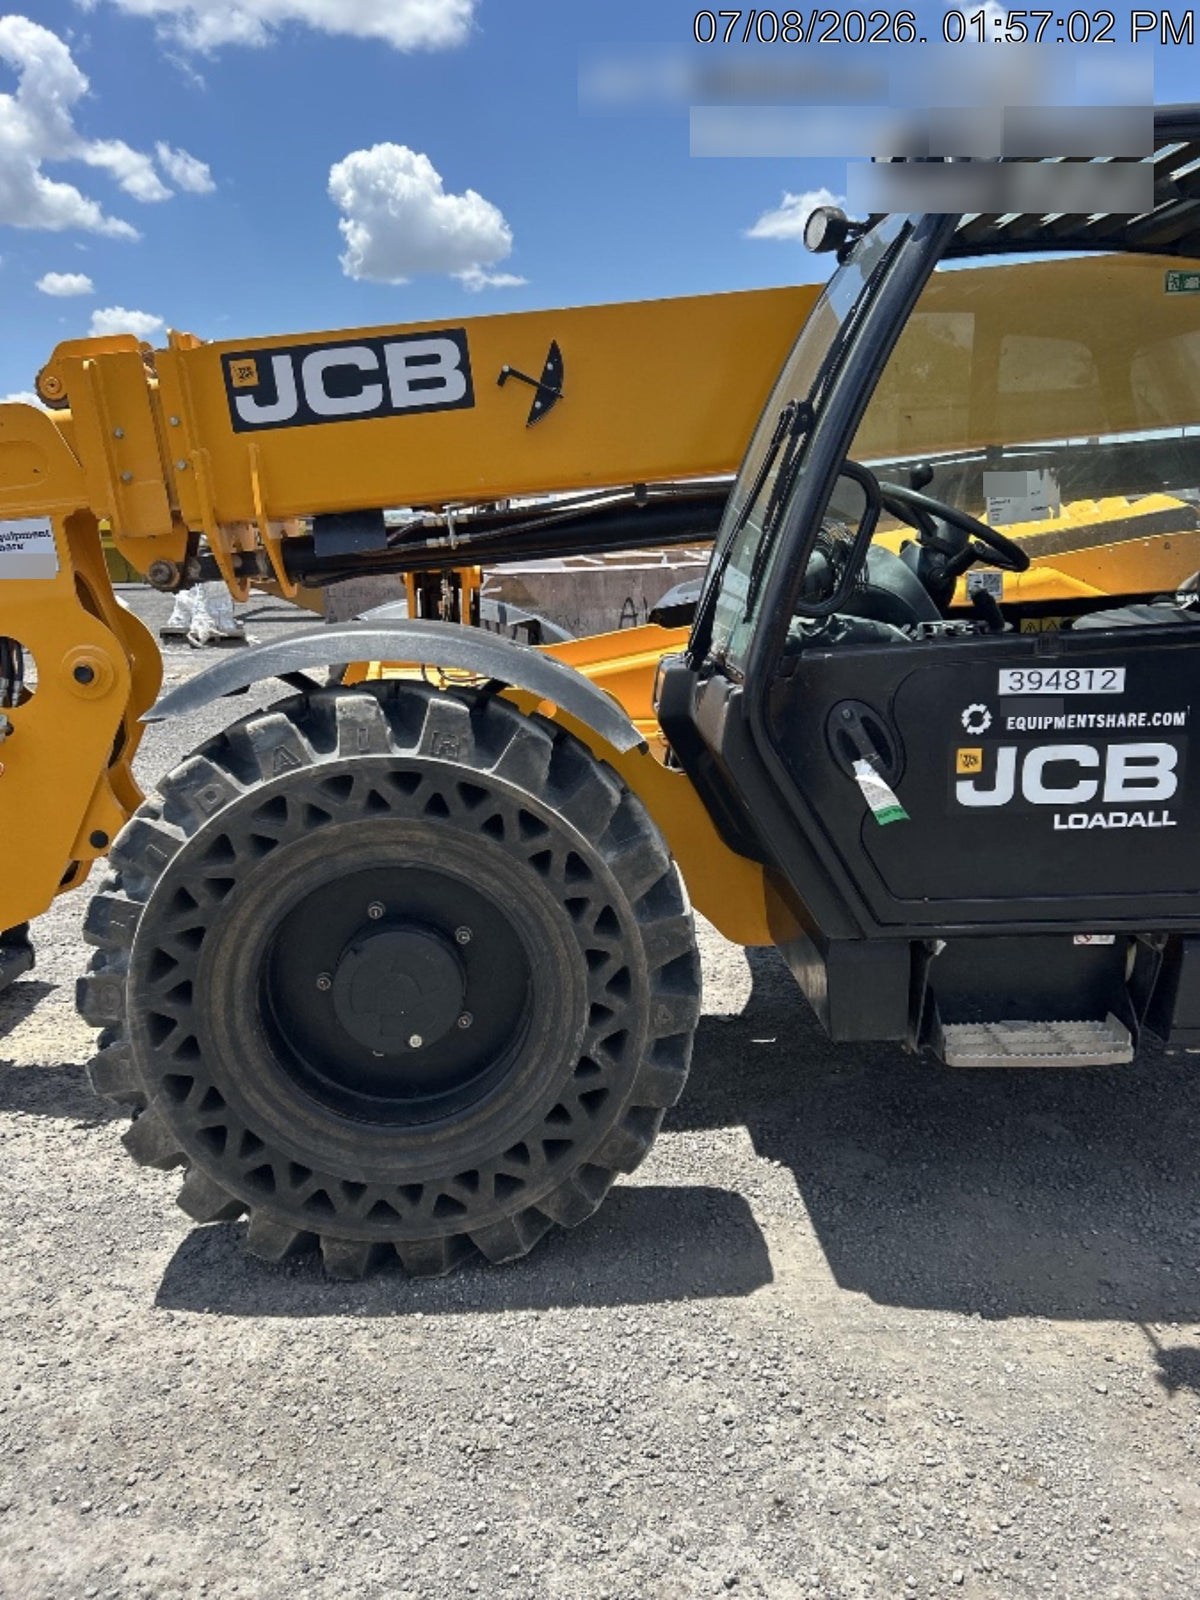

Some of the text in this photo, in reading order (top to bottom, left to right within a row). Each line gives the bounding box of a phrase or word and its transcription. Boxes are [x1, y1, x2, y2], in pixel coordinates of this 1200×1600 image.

[235, 338, 467, 424] JCB
[1008, 669, 1118, 691] 394812
[1006, 712, 1186, 731] EQUIPMENTSHARE.COM
[956, 743, 1178, 807] JCB
[1053, 811, 1177, 830] LOADALL
